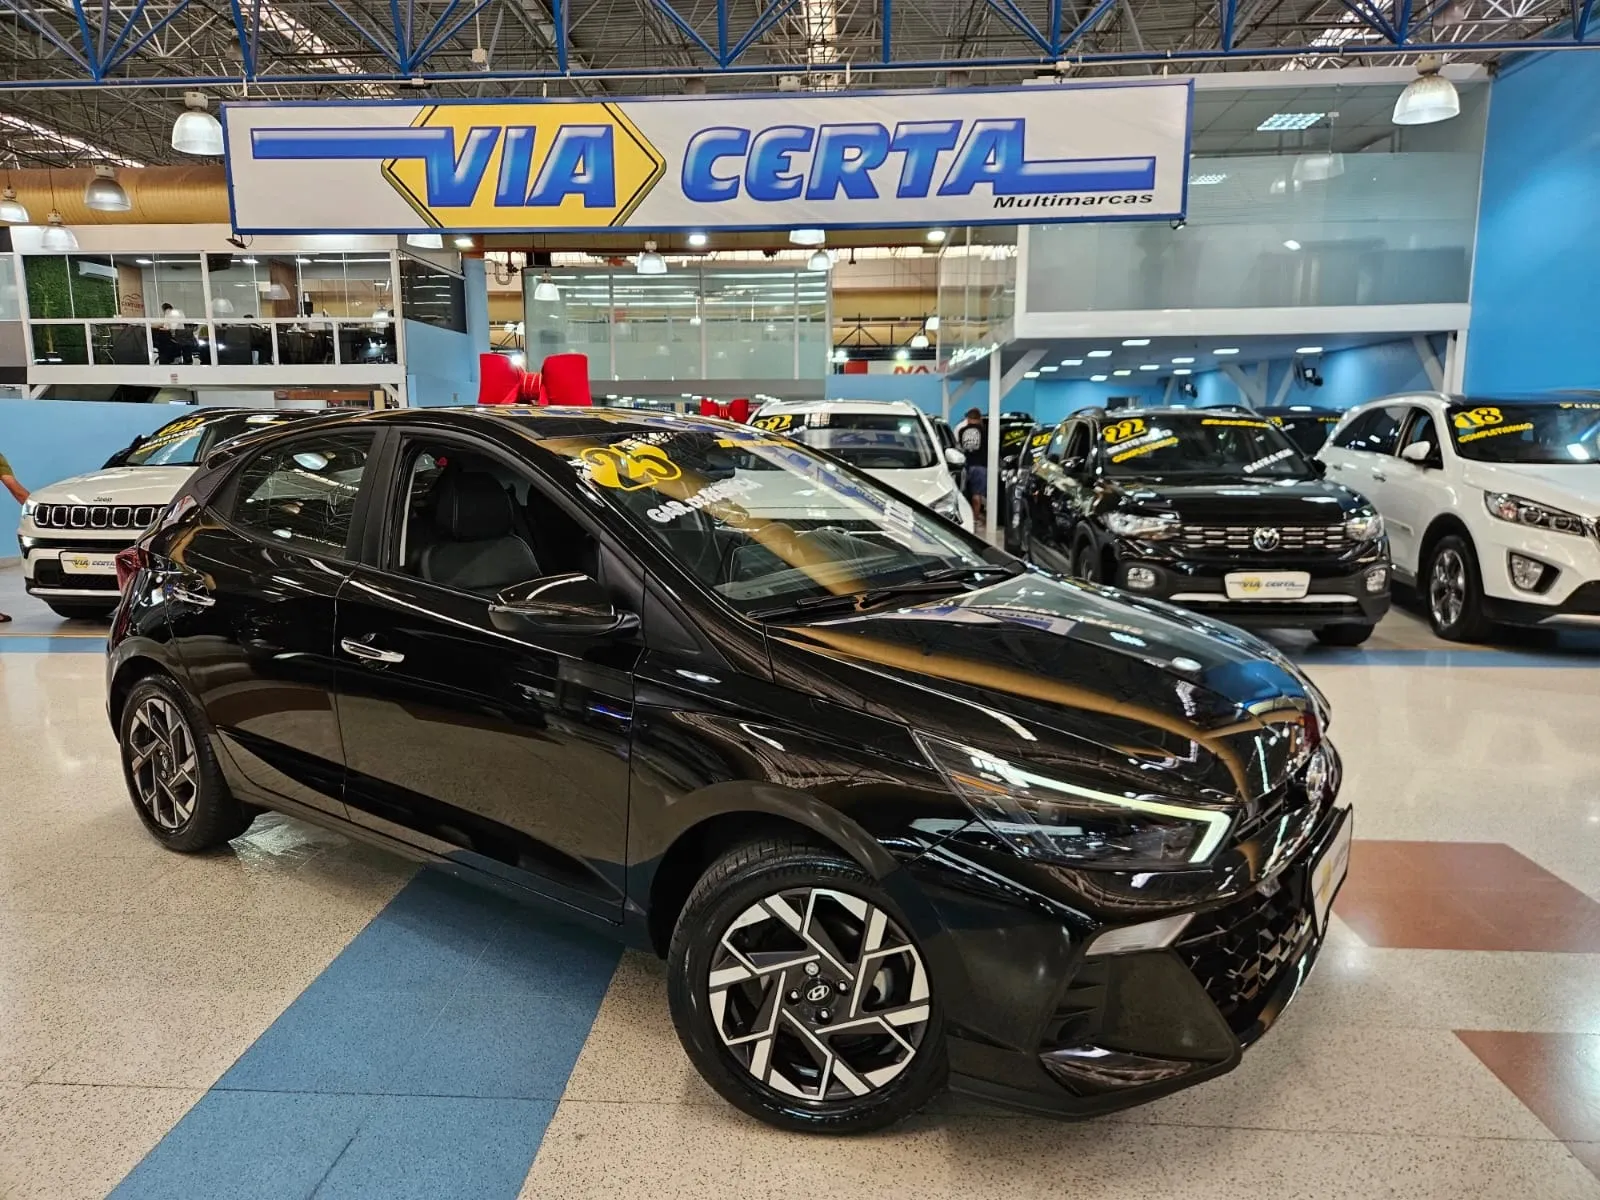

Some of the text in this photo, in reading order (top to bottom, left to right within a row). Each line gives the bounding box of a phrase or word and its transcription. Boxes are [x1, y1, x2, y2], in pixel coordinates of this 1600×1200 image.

[414, 118, 1025, 208] VIA CERTA
[993, 193, 1154, 209] Multimarcas
[1103, 418, 1147, 444] 22
[1454, 407, 1504, 429] 18
[580, 438, 682, 491] 25
